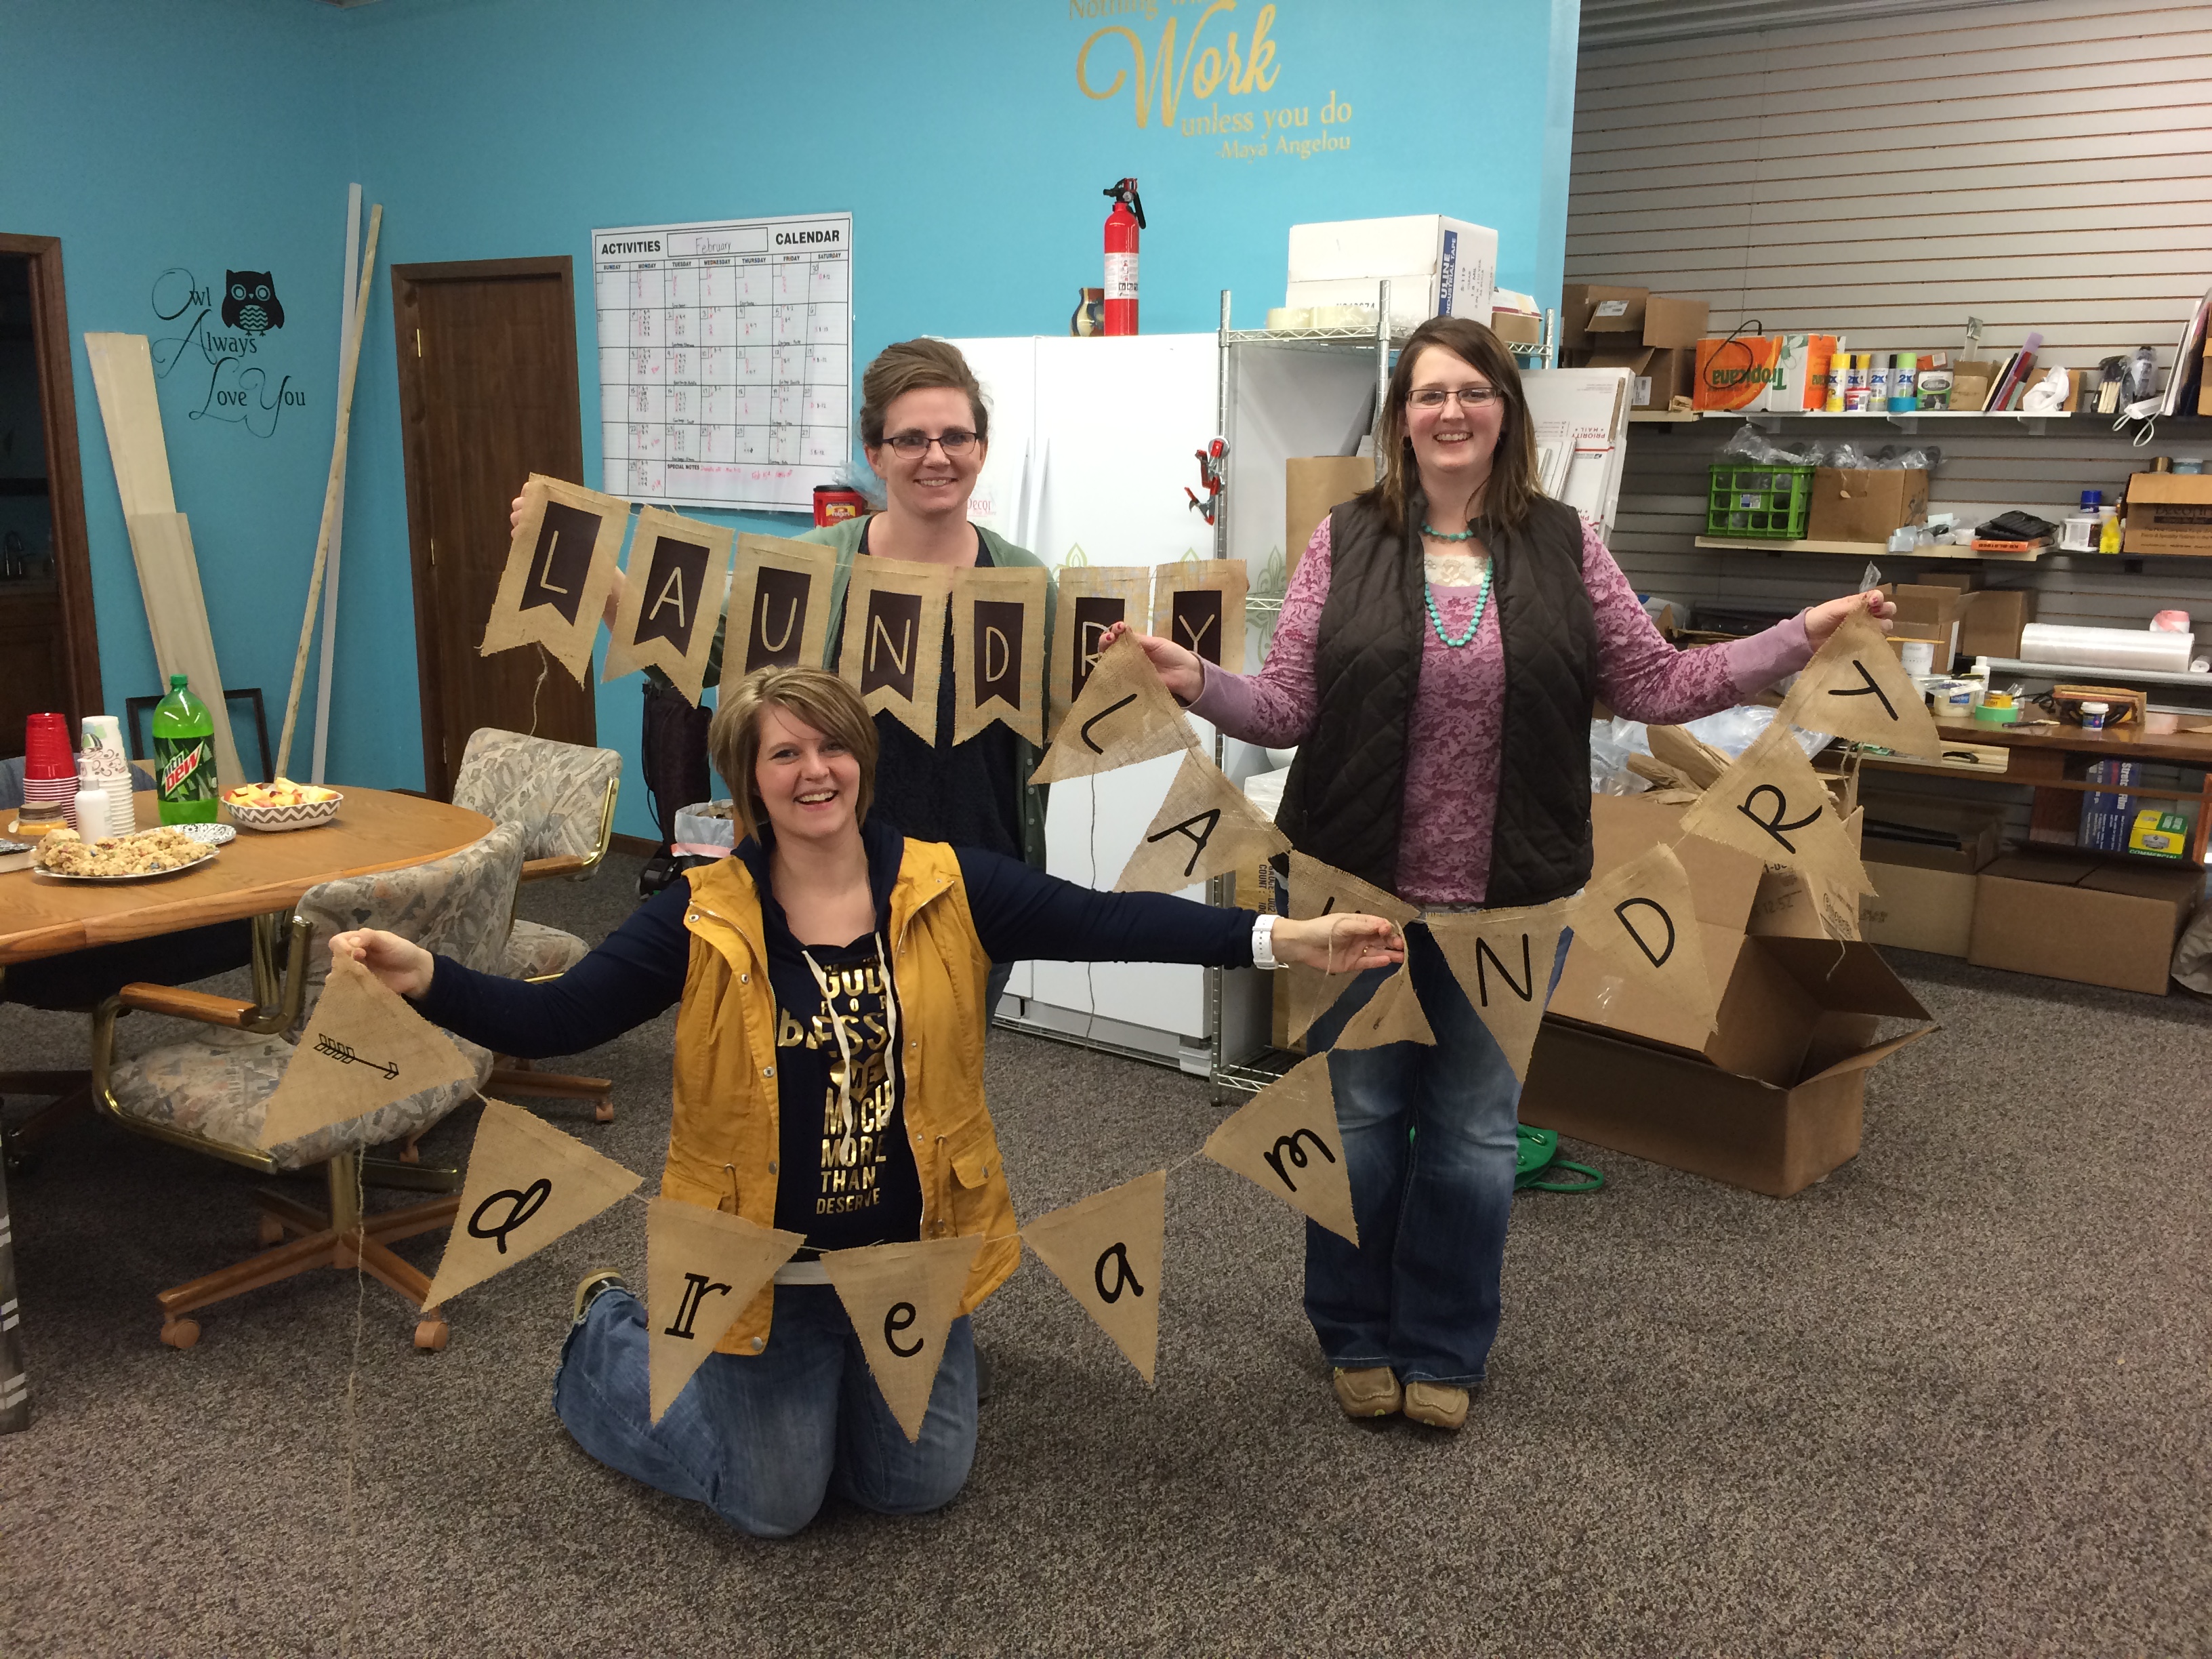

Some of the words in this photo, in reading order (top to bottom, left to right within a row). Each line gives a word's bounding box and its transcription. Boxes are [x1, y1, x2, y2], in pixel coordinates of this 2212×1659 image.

[1076, 0, 1281, 129] Work
[1181, 102, 1254, 138] unless
[1263, 106, 1309, 140] you
[1321, 90, 1351, 125] do
[1275, 129, 1351, 160] Angelou
[601, 240, 661, 255] ACTIVITIES
[696, 237, 731, 255] February
[775, 229, 840, 245] CALENDAR
[1441, 253, 1450, 299] ULINE
[152, 267, 211, 321] Owl
[151, 308, 258, 379] Always
[1712, 364, 1787, 390] Tropicana
[1871, 374, 1885, 383] 2X
[1898, 374, 1913, 383] 2X
[188, 356, 247, 420] Love
[239, 367, 306, 438] You
[821, 1133, 887, 1169] MORE
[821, 1166, 876, 1193] THAN
[816, 1187, 880, 1215] DESERVE
